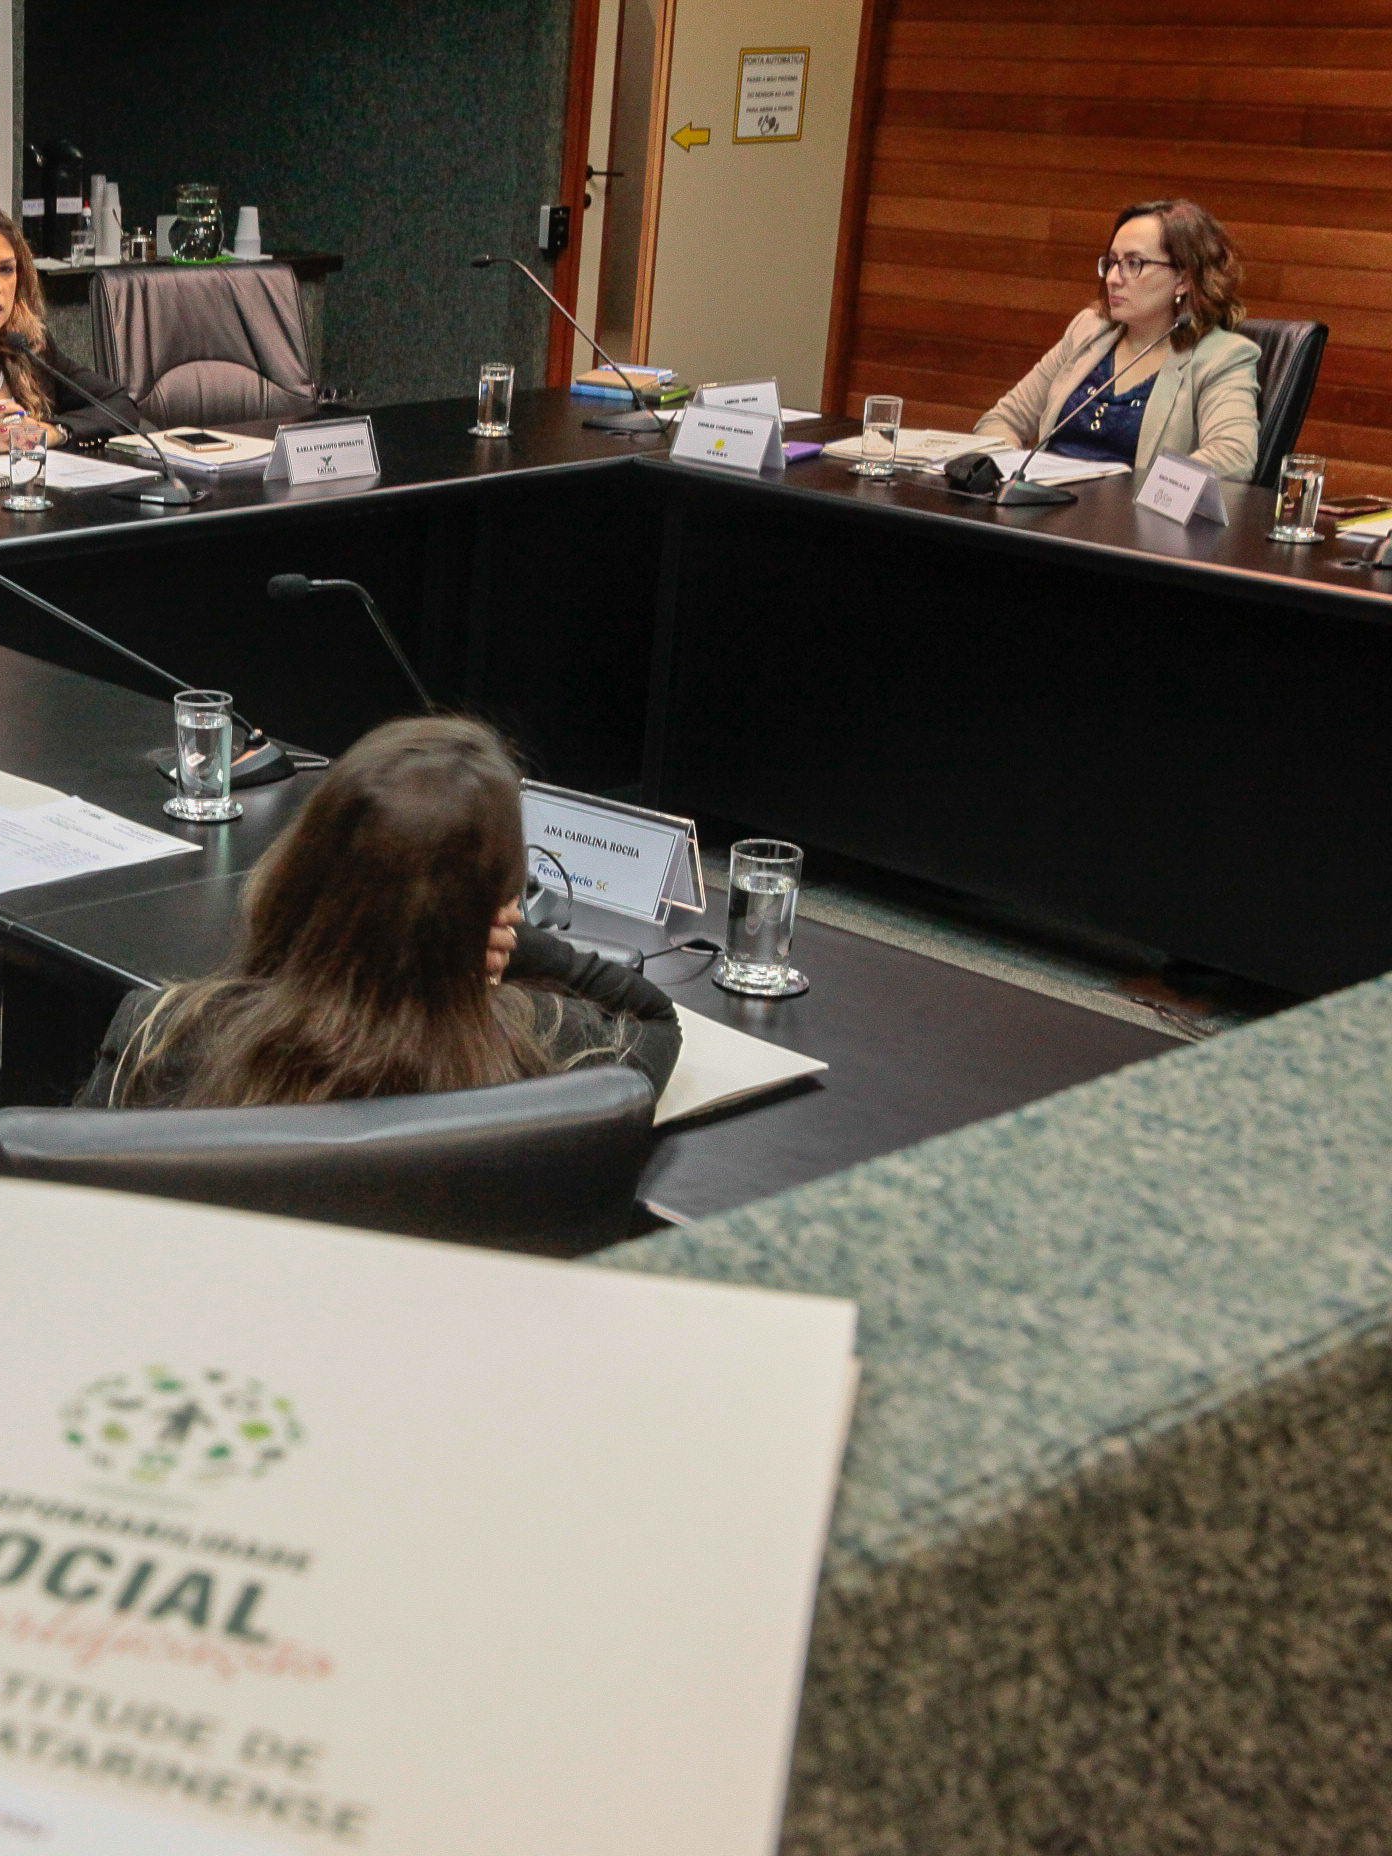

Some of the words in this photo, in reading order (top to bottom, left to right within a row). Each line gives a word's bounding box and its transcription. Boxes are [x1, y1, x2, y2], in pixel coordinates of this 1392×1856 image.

[744, 57, 765, 65] PORTA
[544, 824, 562, 838] ANA
[564, 829, 608, 850] CAROLINA
[609, 842, 640, 859] ROCHA
[595, 879, 608, 892] SC
[237, 1724, 324, 1775] DE
